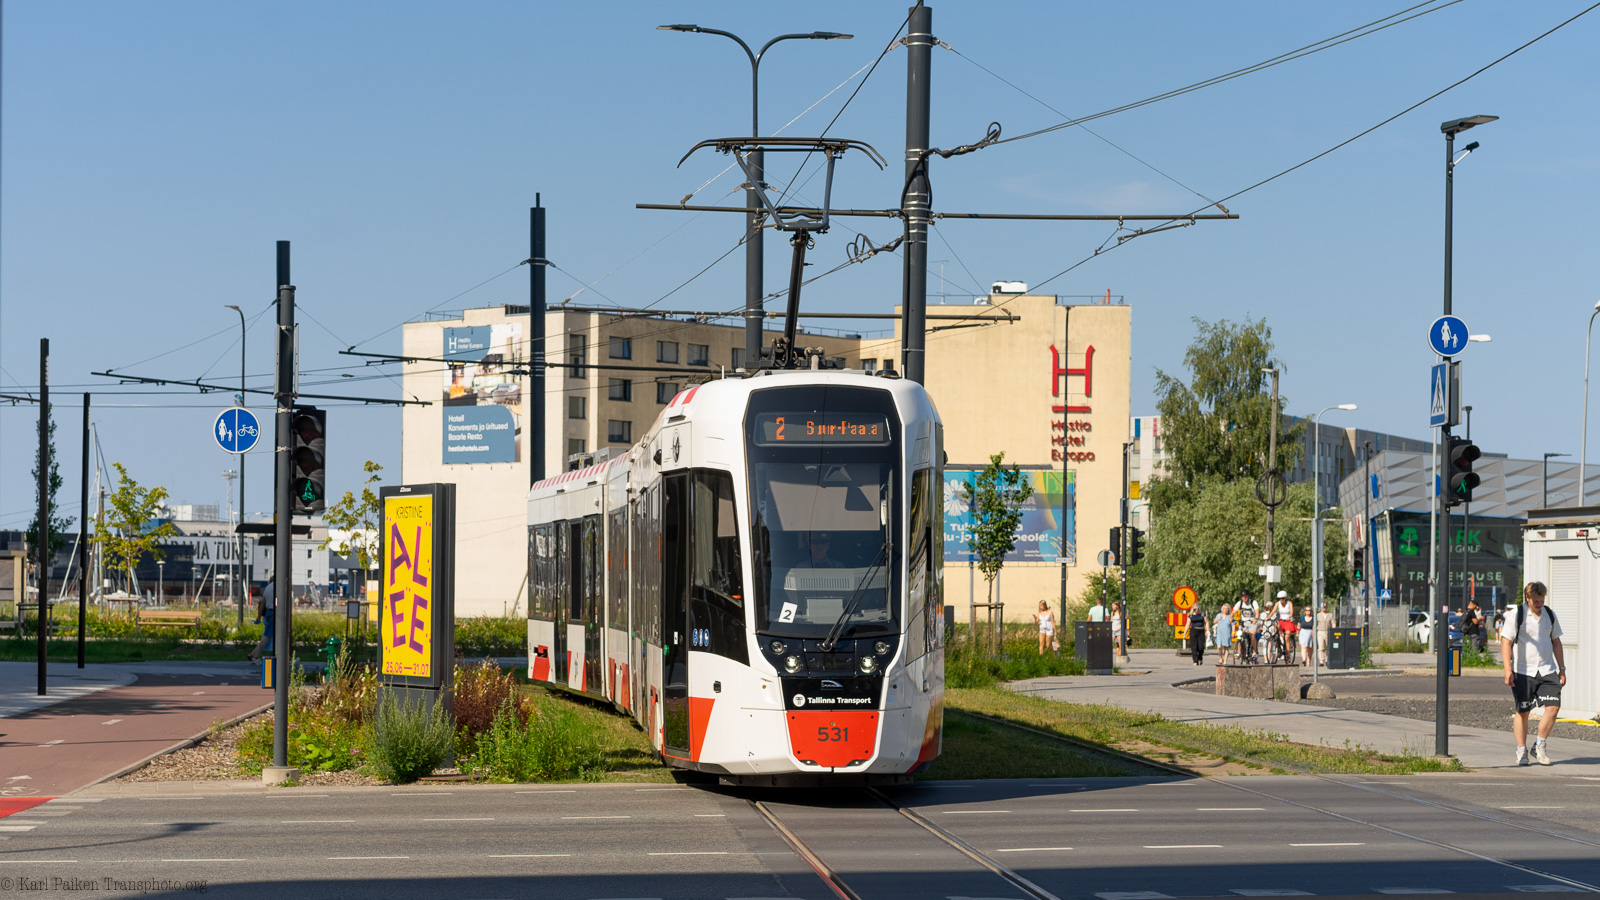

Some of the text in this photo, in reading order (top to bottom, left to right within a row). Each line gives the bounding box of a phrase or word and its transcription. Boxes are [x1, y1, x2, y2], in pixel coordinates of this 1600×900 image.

[448, 414, 464, 422] Hotell
[478, 424, 485, 432] ja
[485, 422, 508, 430] üritused
[776, 417, 785, 440] 2
[783, 609, 792, 620] 2
[837, 697, 872, 705] Transport
[818, 727, 848, 742] 531
